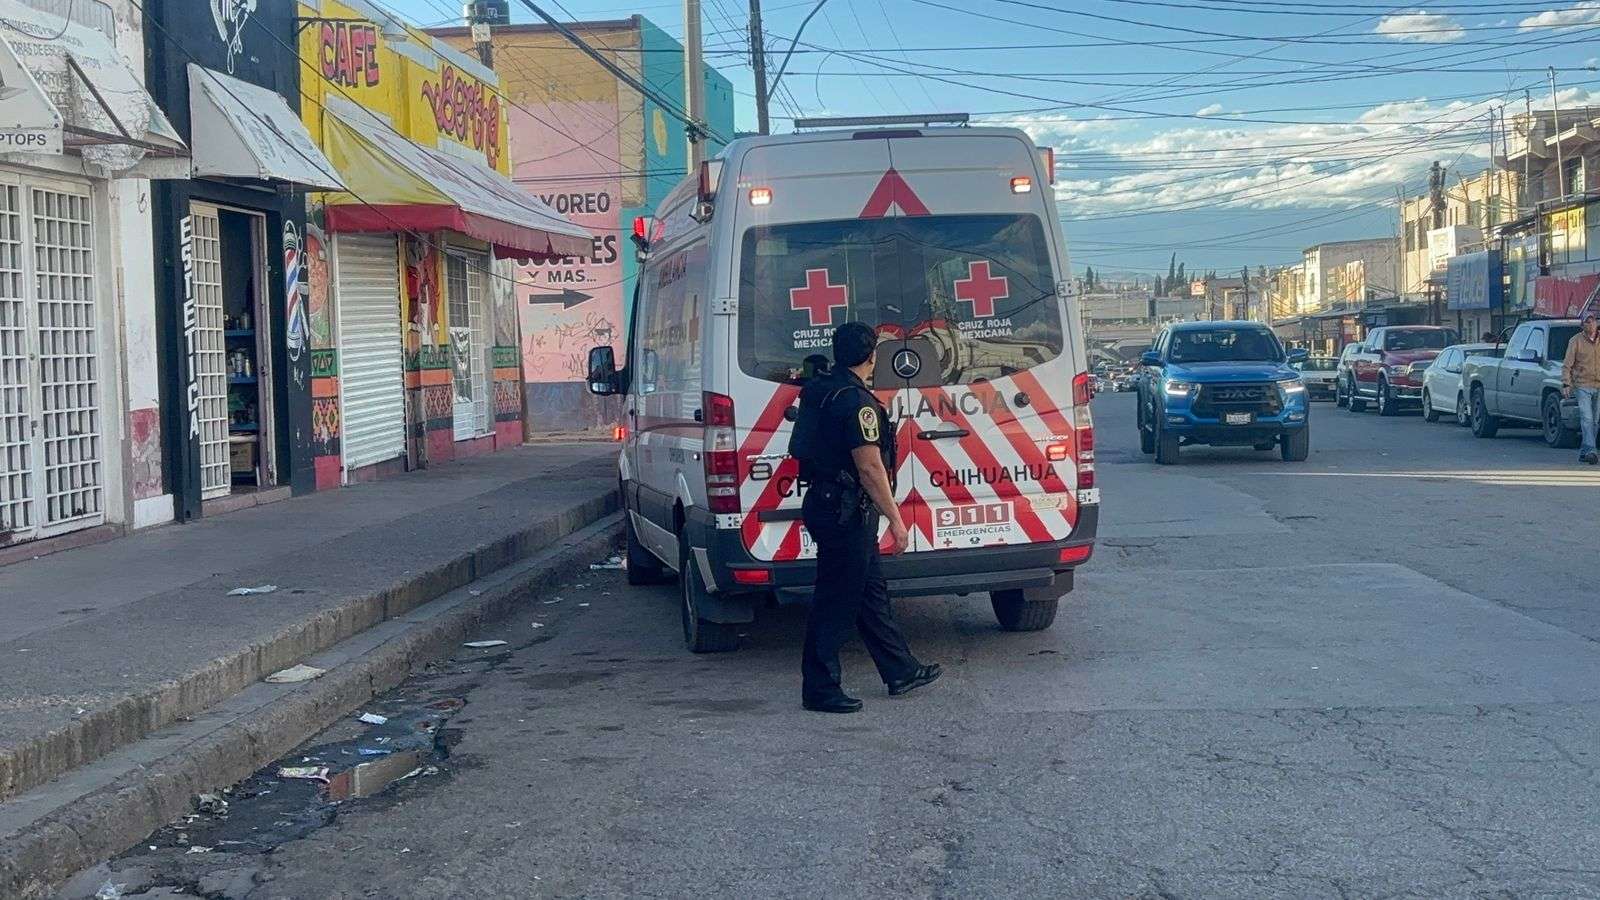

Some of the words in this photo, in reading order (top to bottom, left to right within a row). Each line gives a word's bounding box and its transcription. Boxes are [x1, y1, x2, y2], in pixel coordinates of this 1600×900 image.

[321, 22, 379, 88] CAFE
[533, 192, 611, 214] YOREO
[180, 215, 199, 440] ESTETICA
[793, 329, 820, 339] CRUZ
[958, 320, 984, 331] CRUZ
[987, 318, 1012, 329] ROJA
[958, 327, 1013, 339] MEXICANA
[929, 462, 1059, 489] CHIHUAHUA
[939, 504, 1005, 527] 911
[936, 525, 1011, 538] EMERGENCIAS
